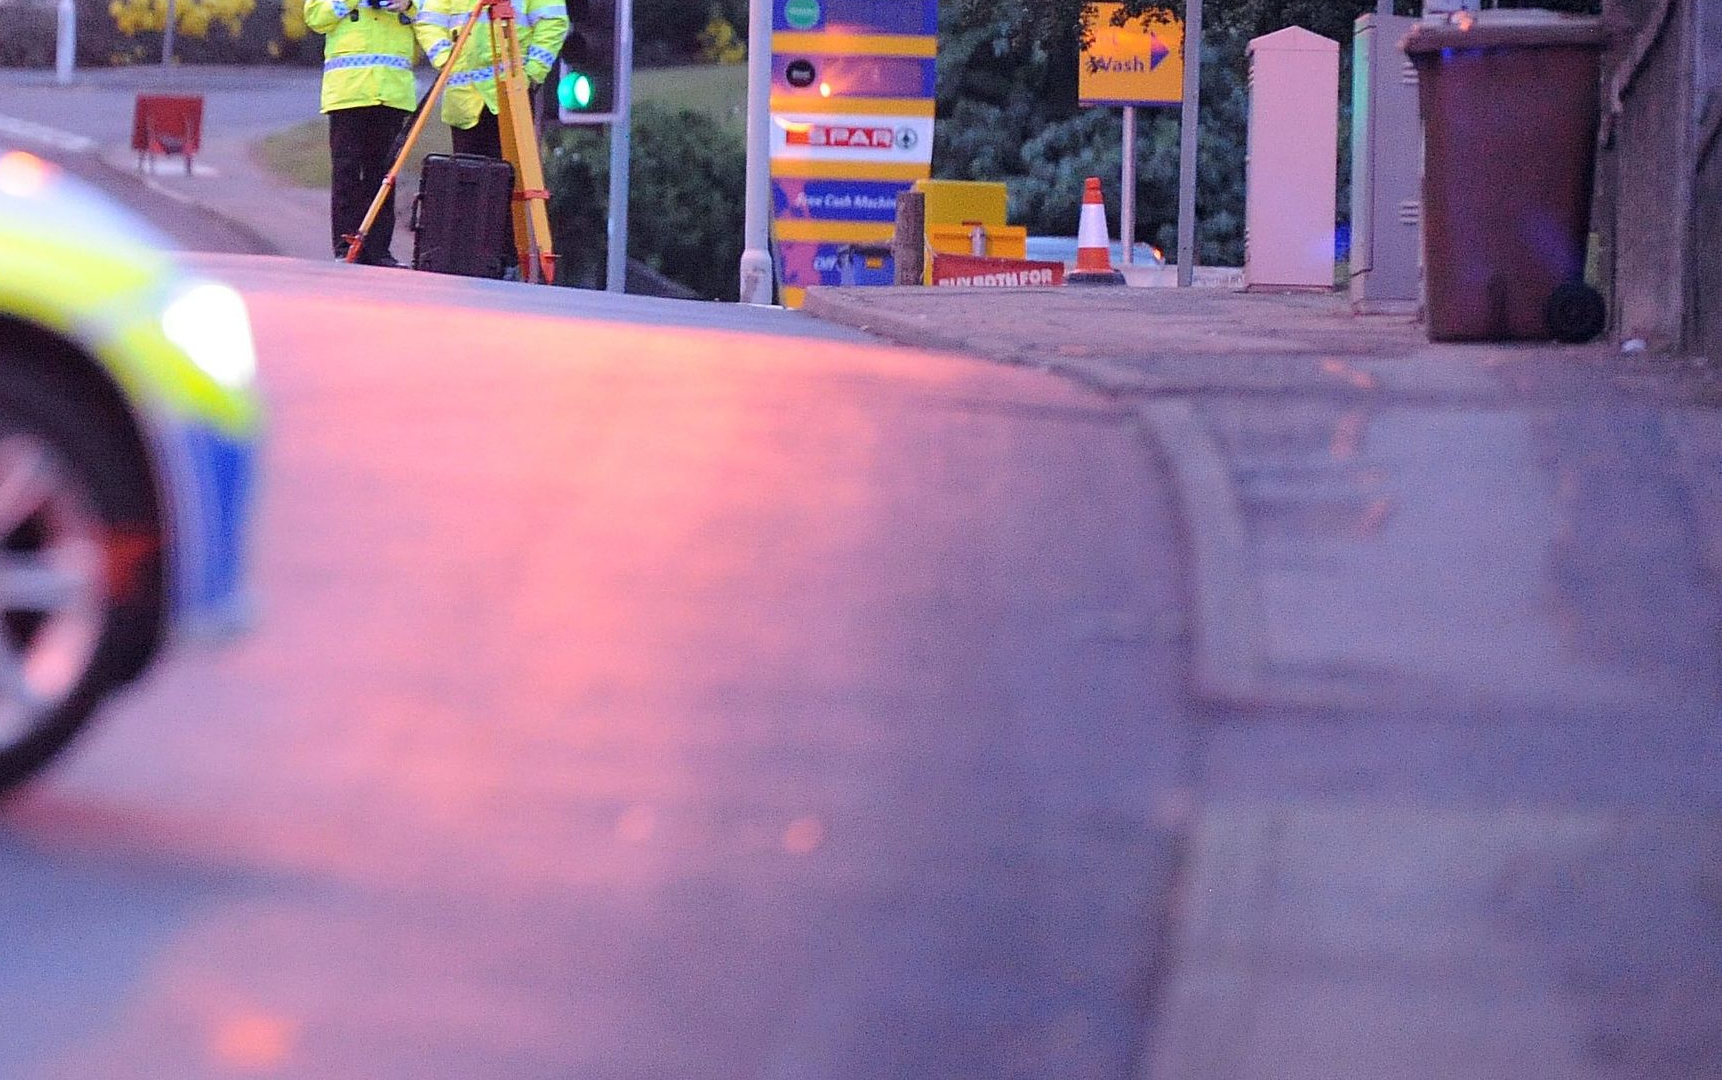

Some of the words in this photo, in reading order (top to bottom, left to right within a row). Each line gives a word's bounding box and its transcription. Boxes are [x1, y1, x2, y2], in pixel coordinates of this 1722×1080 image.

[811, 126, 892, 147] SPAR
[854, 194, 897, 209] Machin
[1019, 268, 1053, 286] FOR
